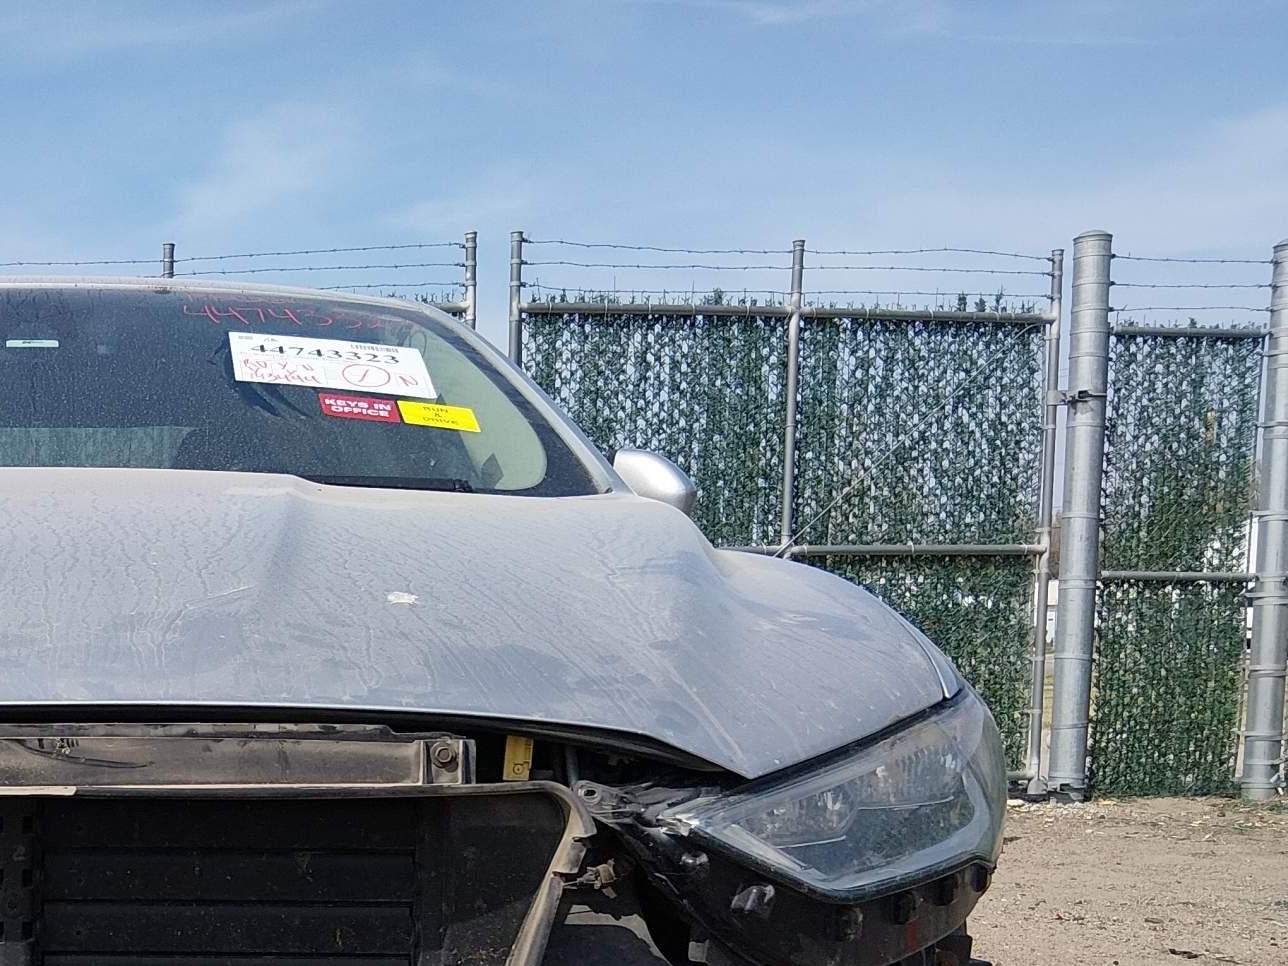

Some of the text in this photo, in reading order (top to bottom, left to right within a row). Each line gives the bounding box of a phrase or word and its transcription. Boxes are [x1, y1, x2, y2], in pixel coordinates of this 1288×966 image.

[250, 344, 400, 365] 44743323
[324, 398, 392, 411] KEYS IN
[330, 405, 390, 417] OFFICE
